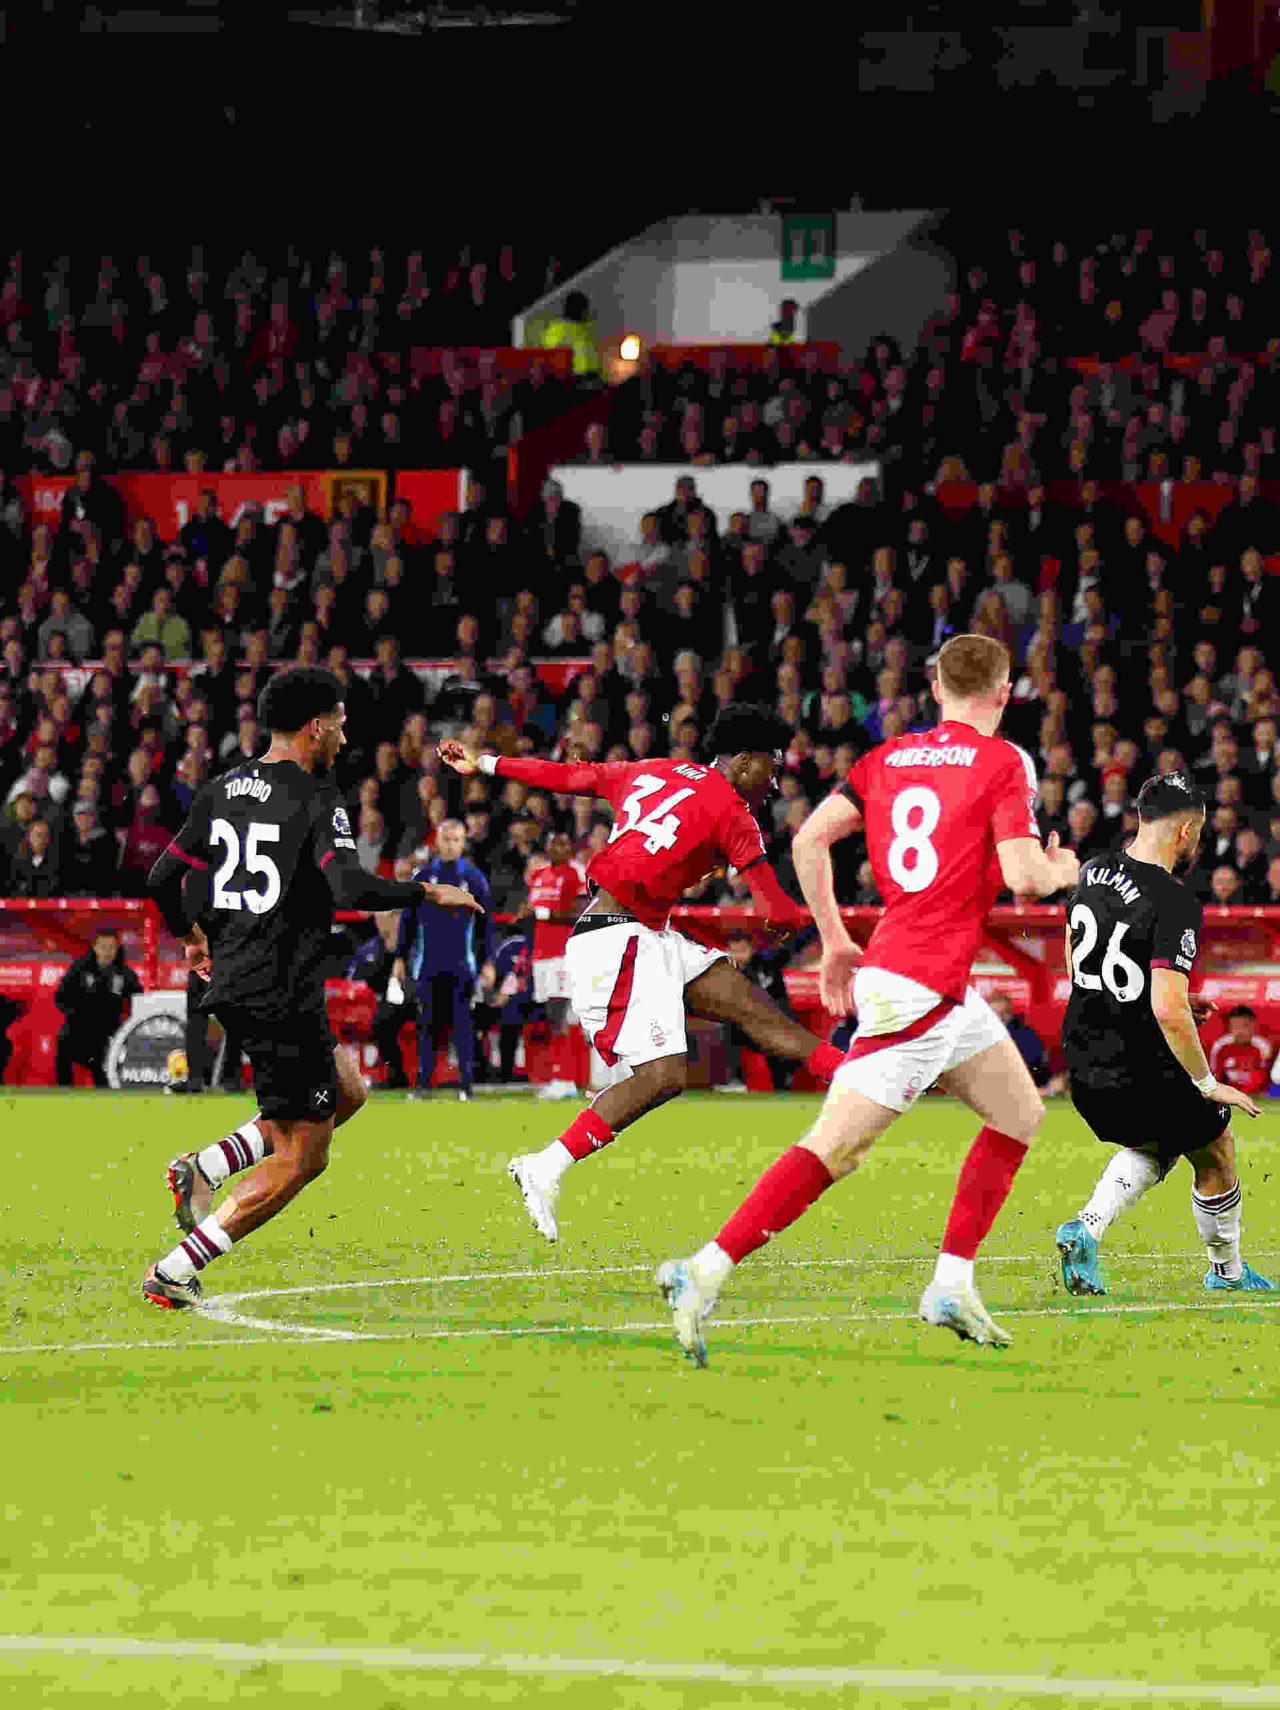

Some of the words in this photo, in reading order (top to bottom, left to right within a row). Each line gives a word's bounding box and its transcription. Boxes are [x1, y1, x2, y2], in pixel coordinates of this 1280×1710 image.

[225, 777, 272, 802] TODIBO
[885, 745, 977, 767] ANDERSON
[607, 774, 696, 855] 34
[888, 786, 940, 893] 8
[209, 818, 281, 914] 25
[1086, 867, 1141, 905] KILMAN
[1071, 904, 1145, 1002] 26
